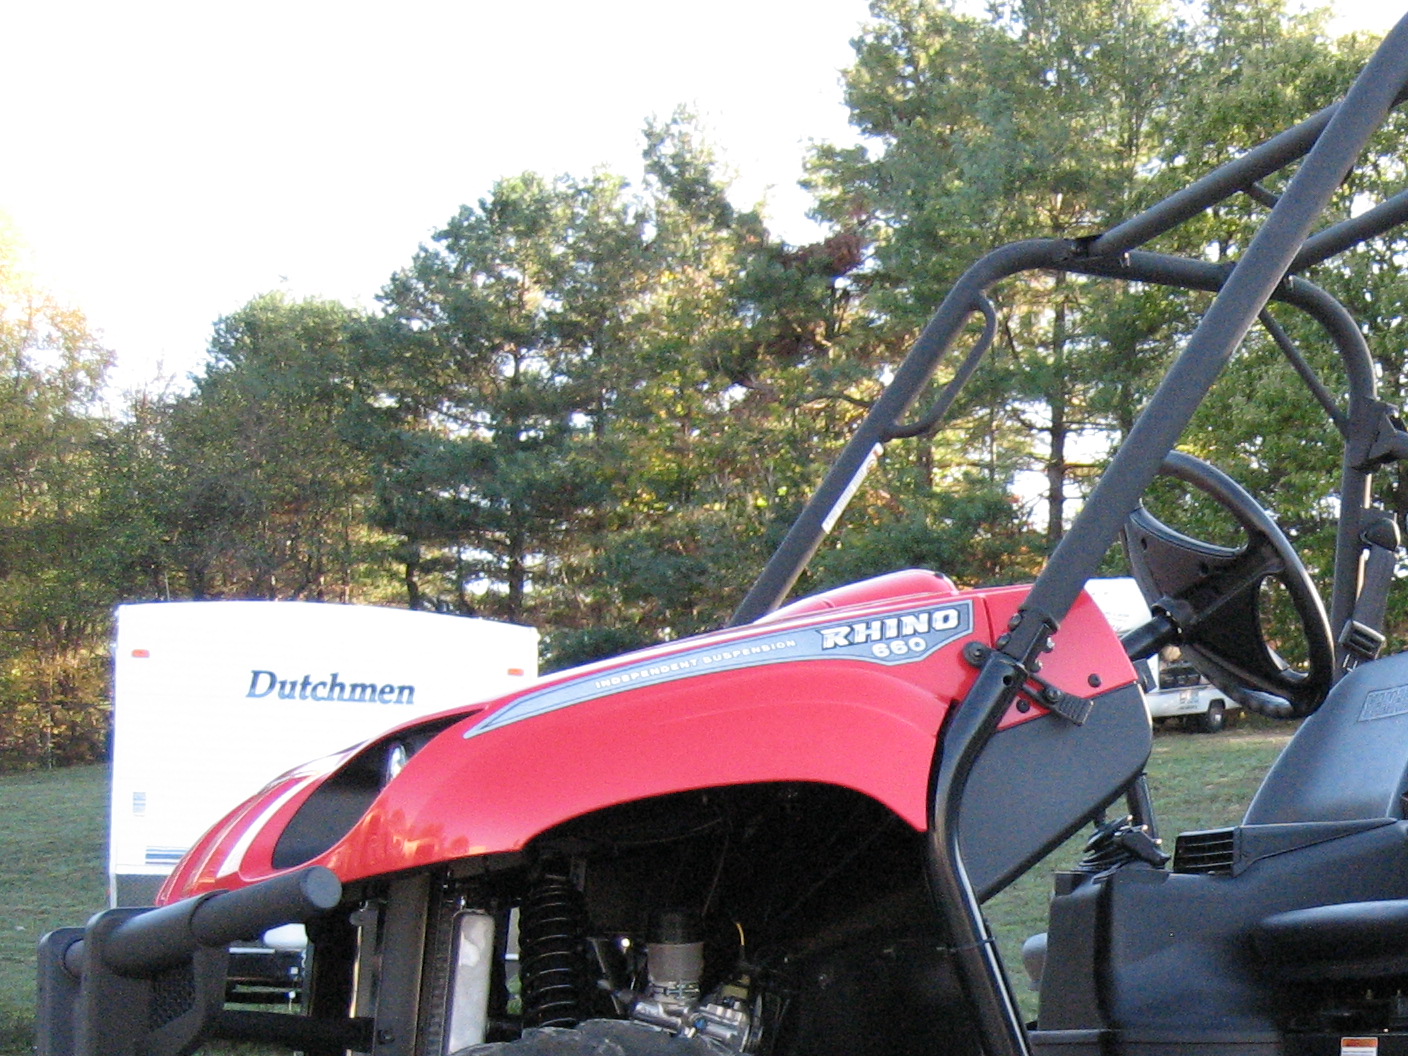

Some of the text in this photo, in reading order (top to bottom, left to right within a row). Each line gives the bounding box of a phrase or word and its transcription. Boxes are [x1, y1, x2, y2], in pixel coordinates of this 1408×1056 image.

[818, 608, 959, 650] RHINO
[871, 636, 927, 658] 660
[595, 640, 797, 689] INDEPENDENT SUSPENSION
[246, 669, 416, 705] Dutchmen
